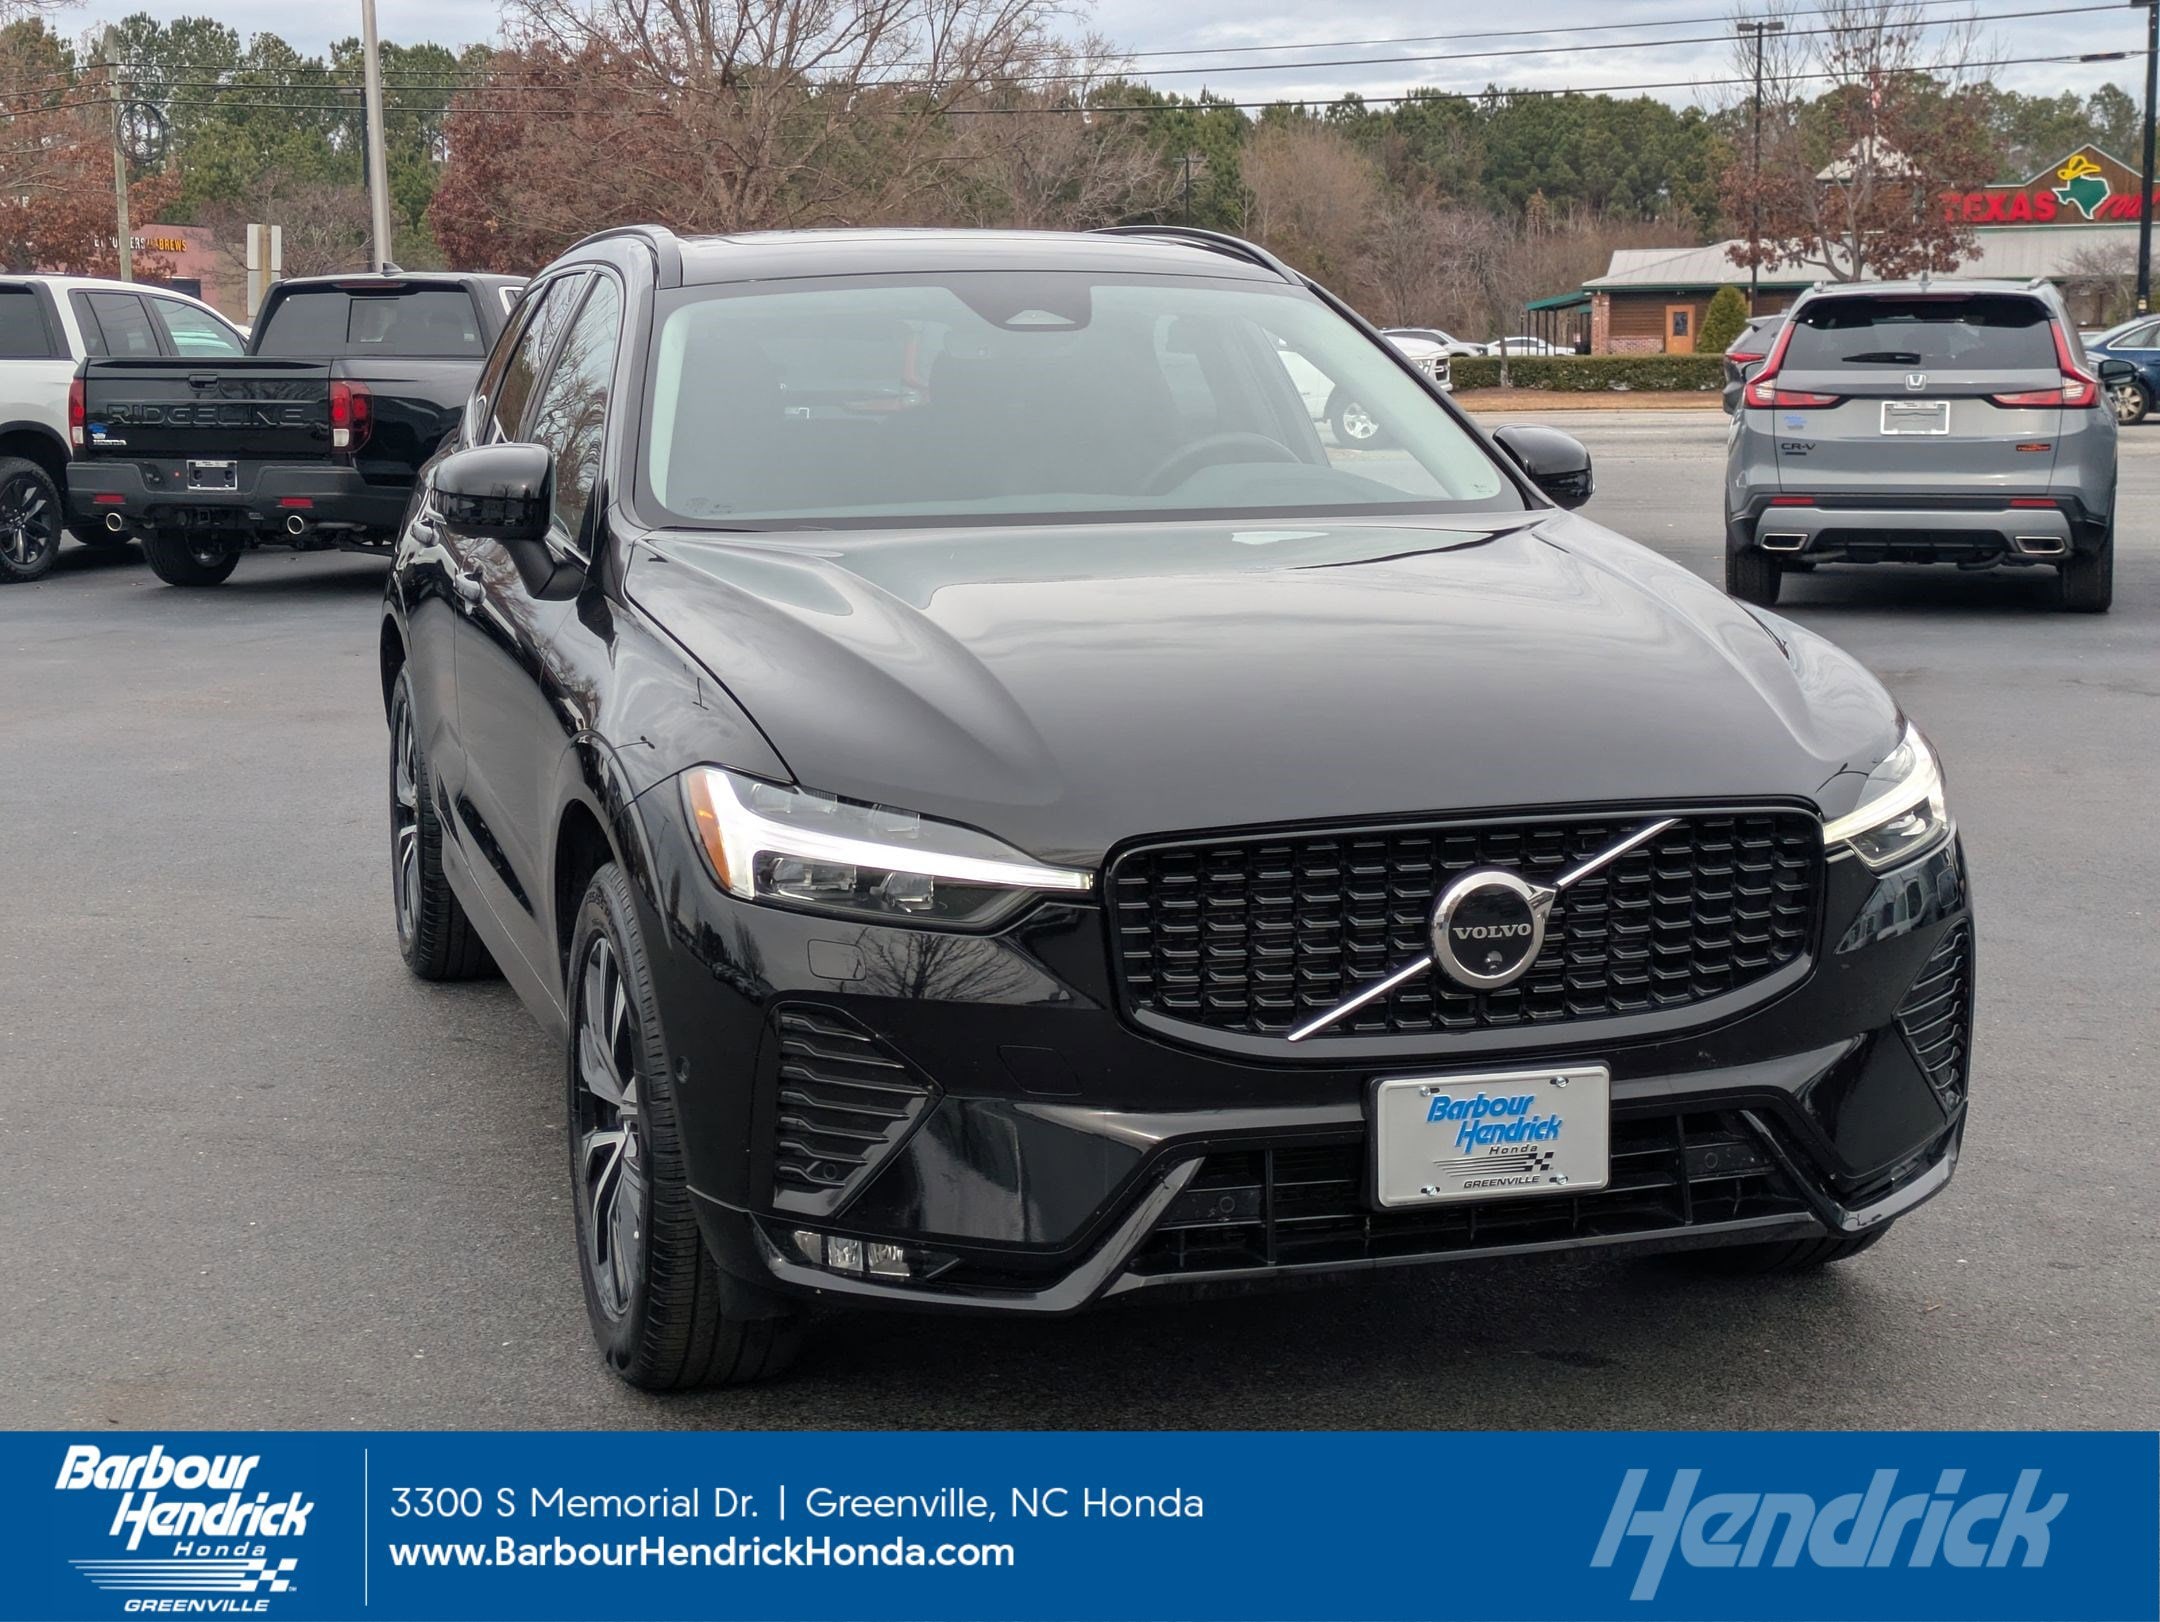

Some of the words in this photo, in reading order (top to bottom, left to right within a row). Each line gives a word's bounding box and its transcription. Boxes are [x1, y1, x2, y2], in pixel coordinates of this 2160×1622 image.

[1939, 191, 2058, 223] TEXAS
[159, 238, 187, 251] BREWS
[106, 404, 305, 425] RIDGELINE
[1781, 442, 1816, 450] CR-V
[1453, 923, 1531, 939] VOLVO
[1427, 1093, 1534, 1122] Barbour
[1455, 1114, 1562, 1154] Hendrick
[1489, 1144, 1538, 1155] Honda
[1464, 1175, 1540, 1188] GREENVILLE
